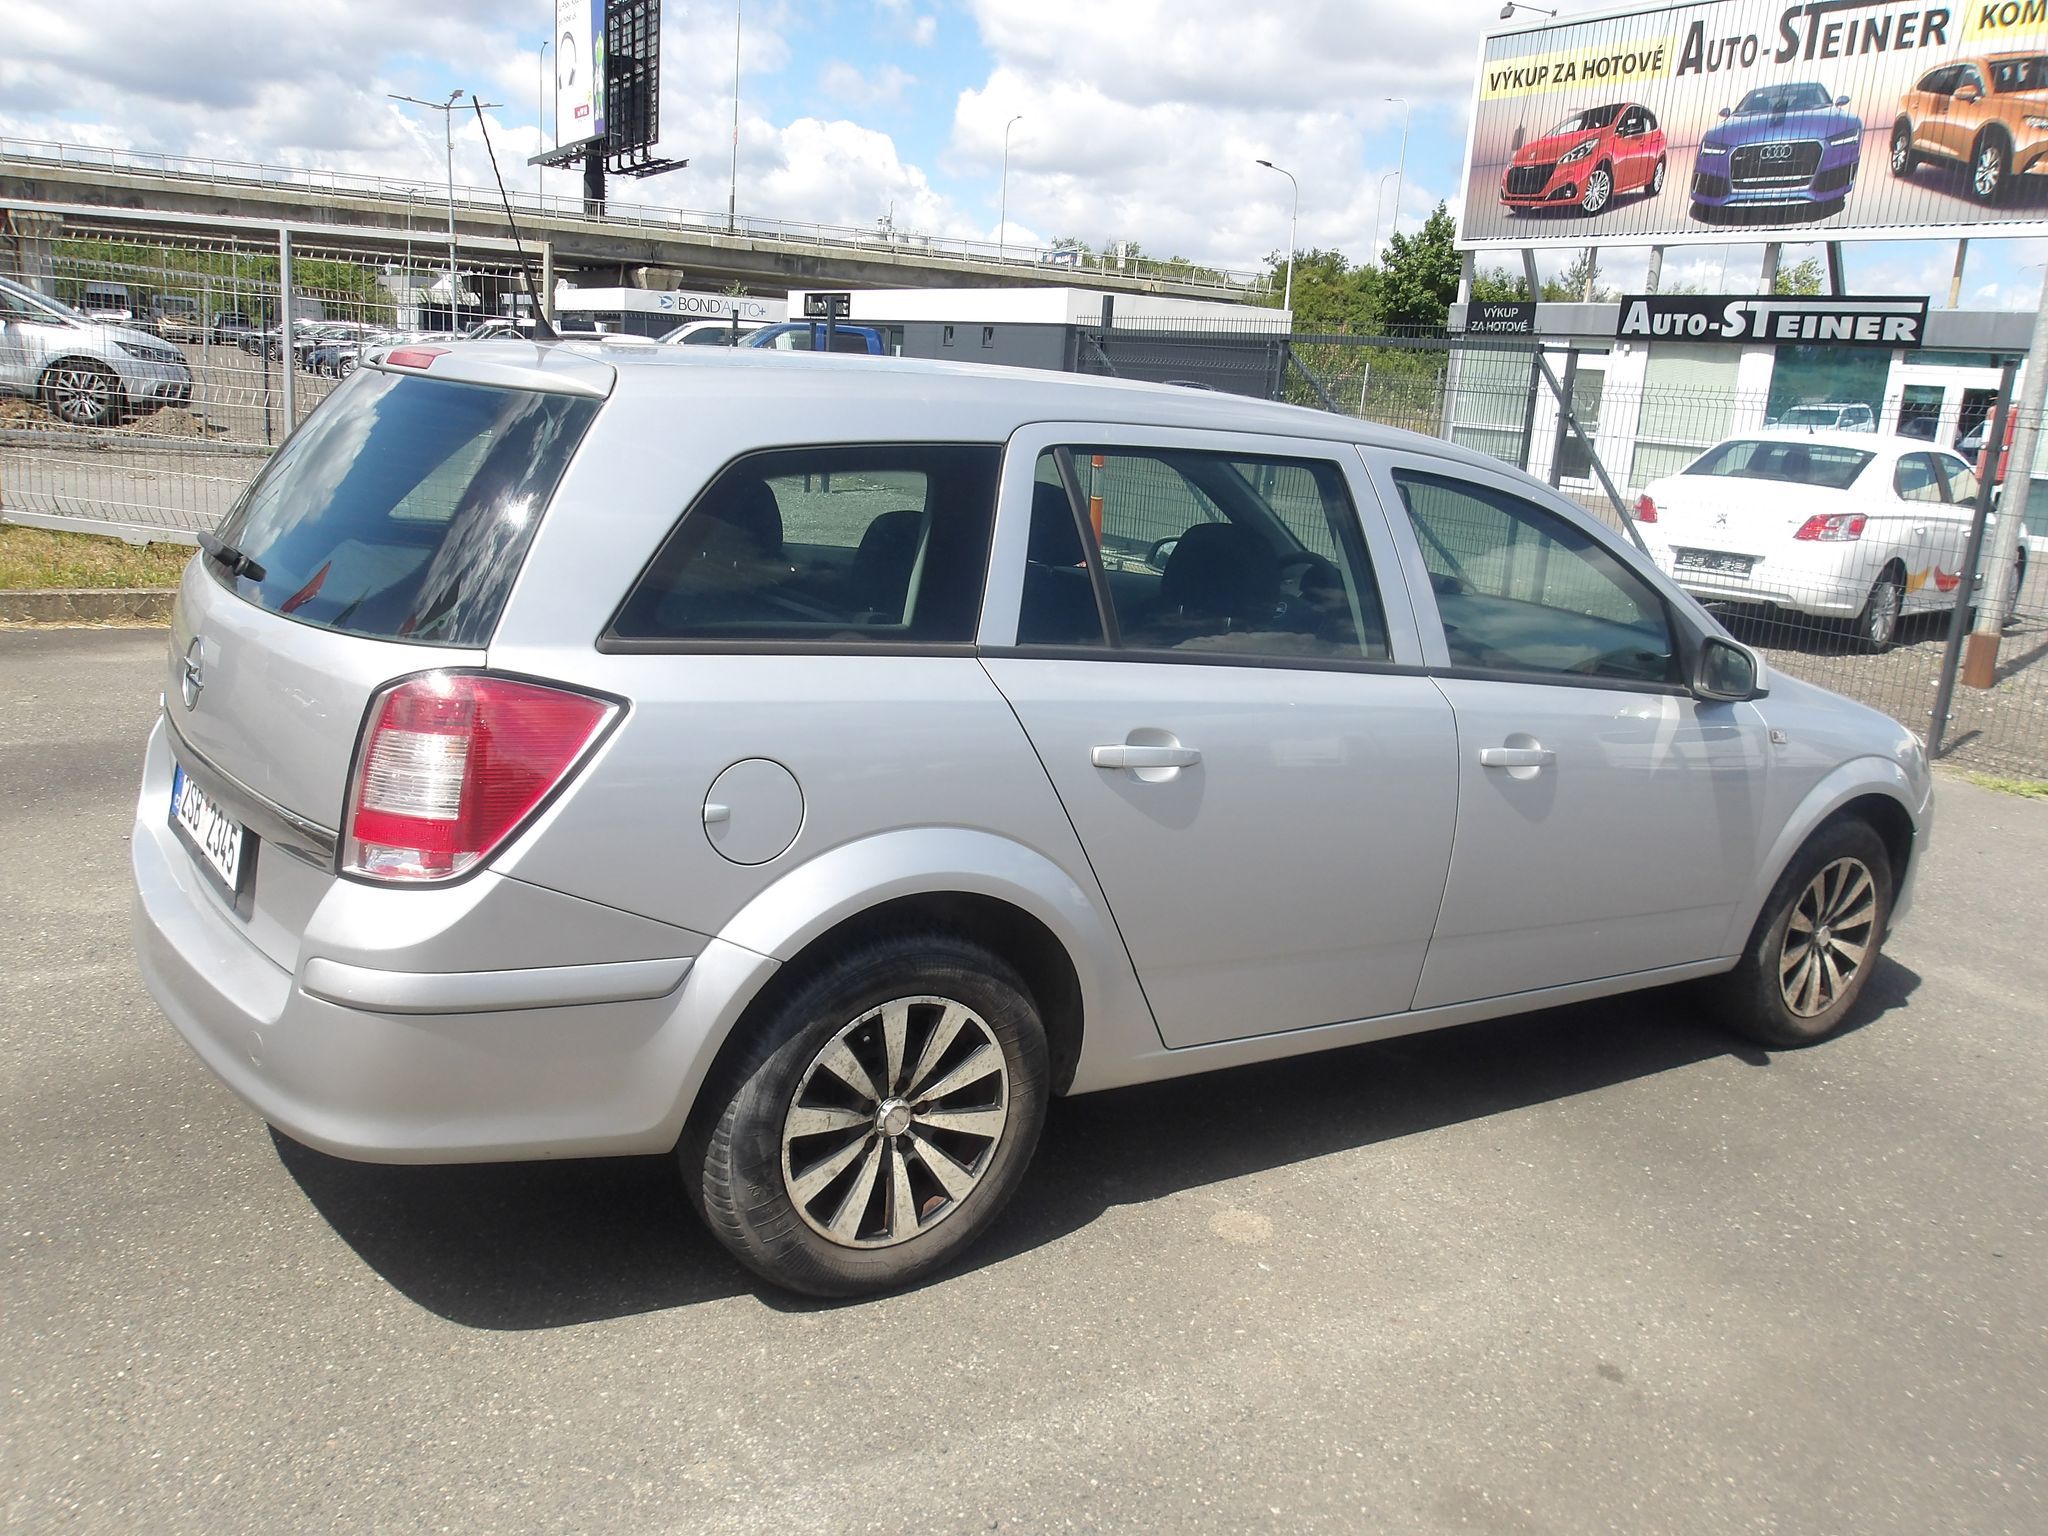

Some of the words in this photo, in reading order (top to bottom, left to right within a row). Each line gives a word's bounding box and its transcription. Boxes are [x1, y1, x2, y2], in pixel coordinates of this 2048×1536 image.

[1490, 66, 1549, 91] VÝKUP
[1552, 61, 1576, 83] ZA
[1581, 44, 1664, 80] HOTOVÉ
[1471, 321, 1484, 331] ZA
[1486, 319, 1528, 332] HOTOVÉ
[1483, 305, 1519, 318] VÝKUP
[206, 802, 237, 875] 2345
